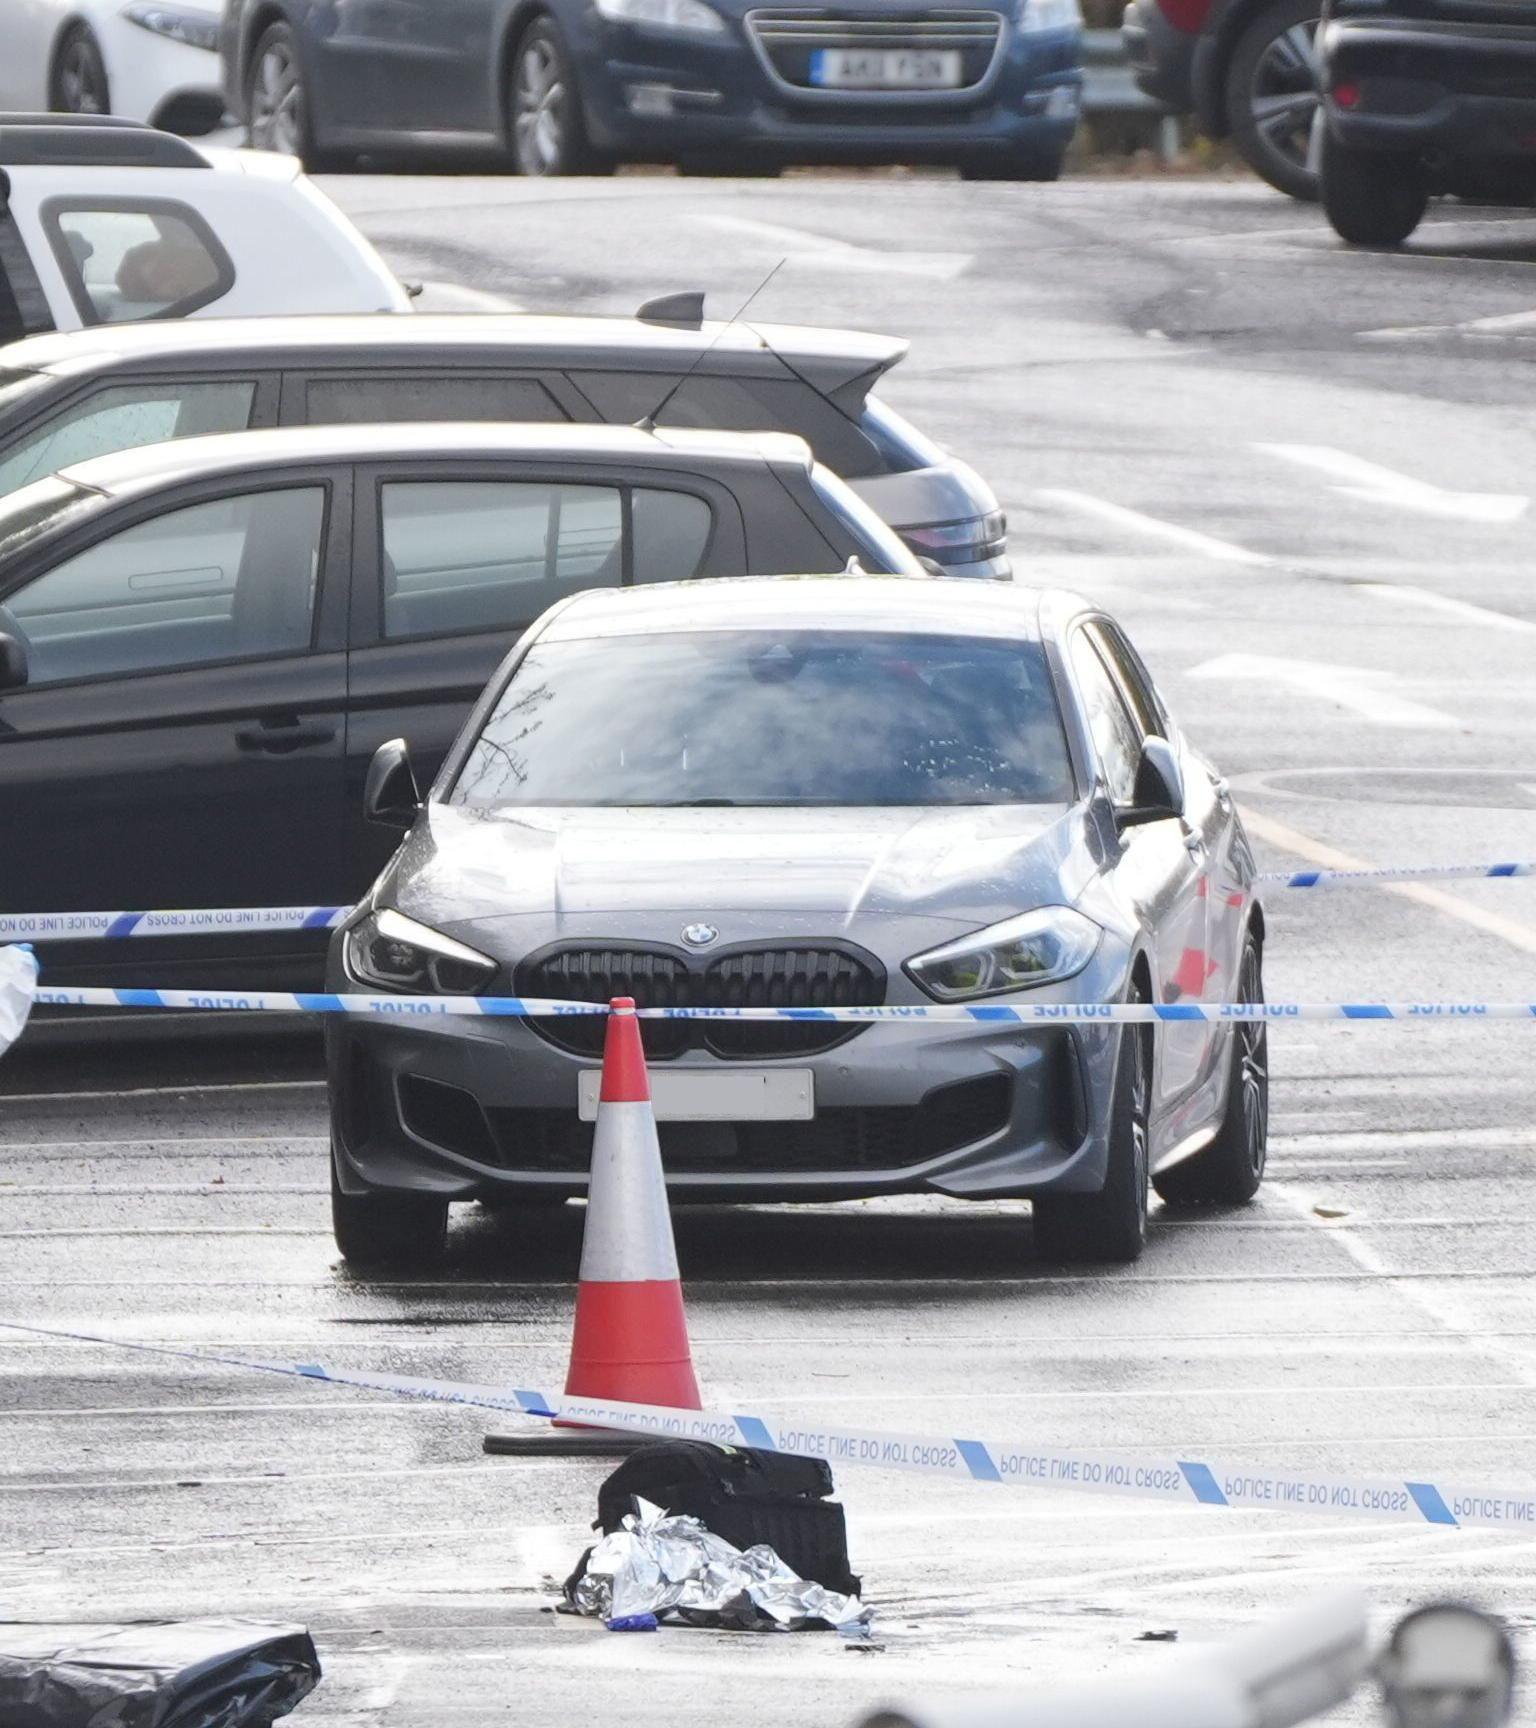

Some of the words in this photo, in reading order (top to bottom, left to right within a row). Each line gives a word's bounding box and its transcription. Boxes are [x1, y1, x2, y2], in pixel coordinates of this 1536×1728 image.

[19, 917, 36, 932] DO
[39, 917, 65, 931] LINE
[67, 916, 109, 930] POLICE
